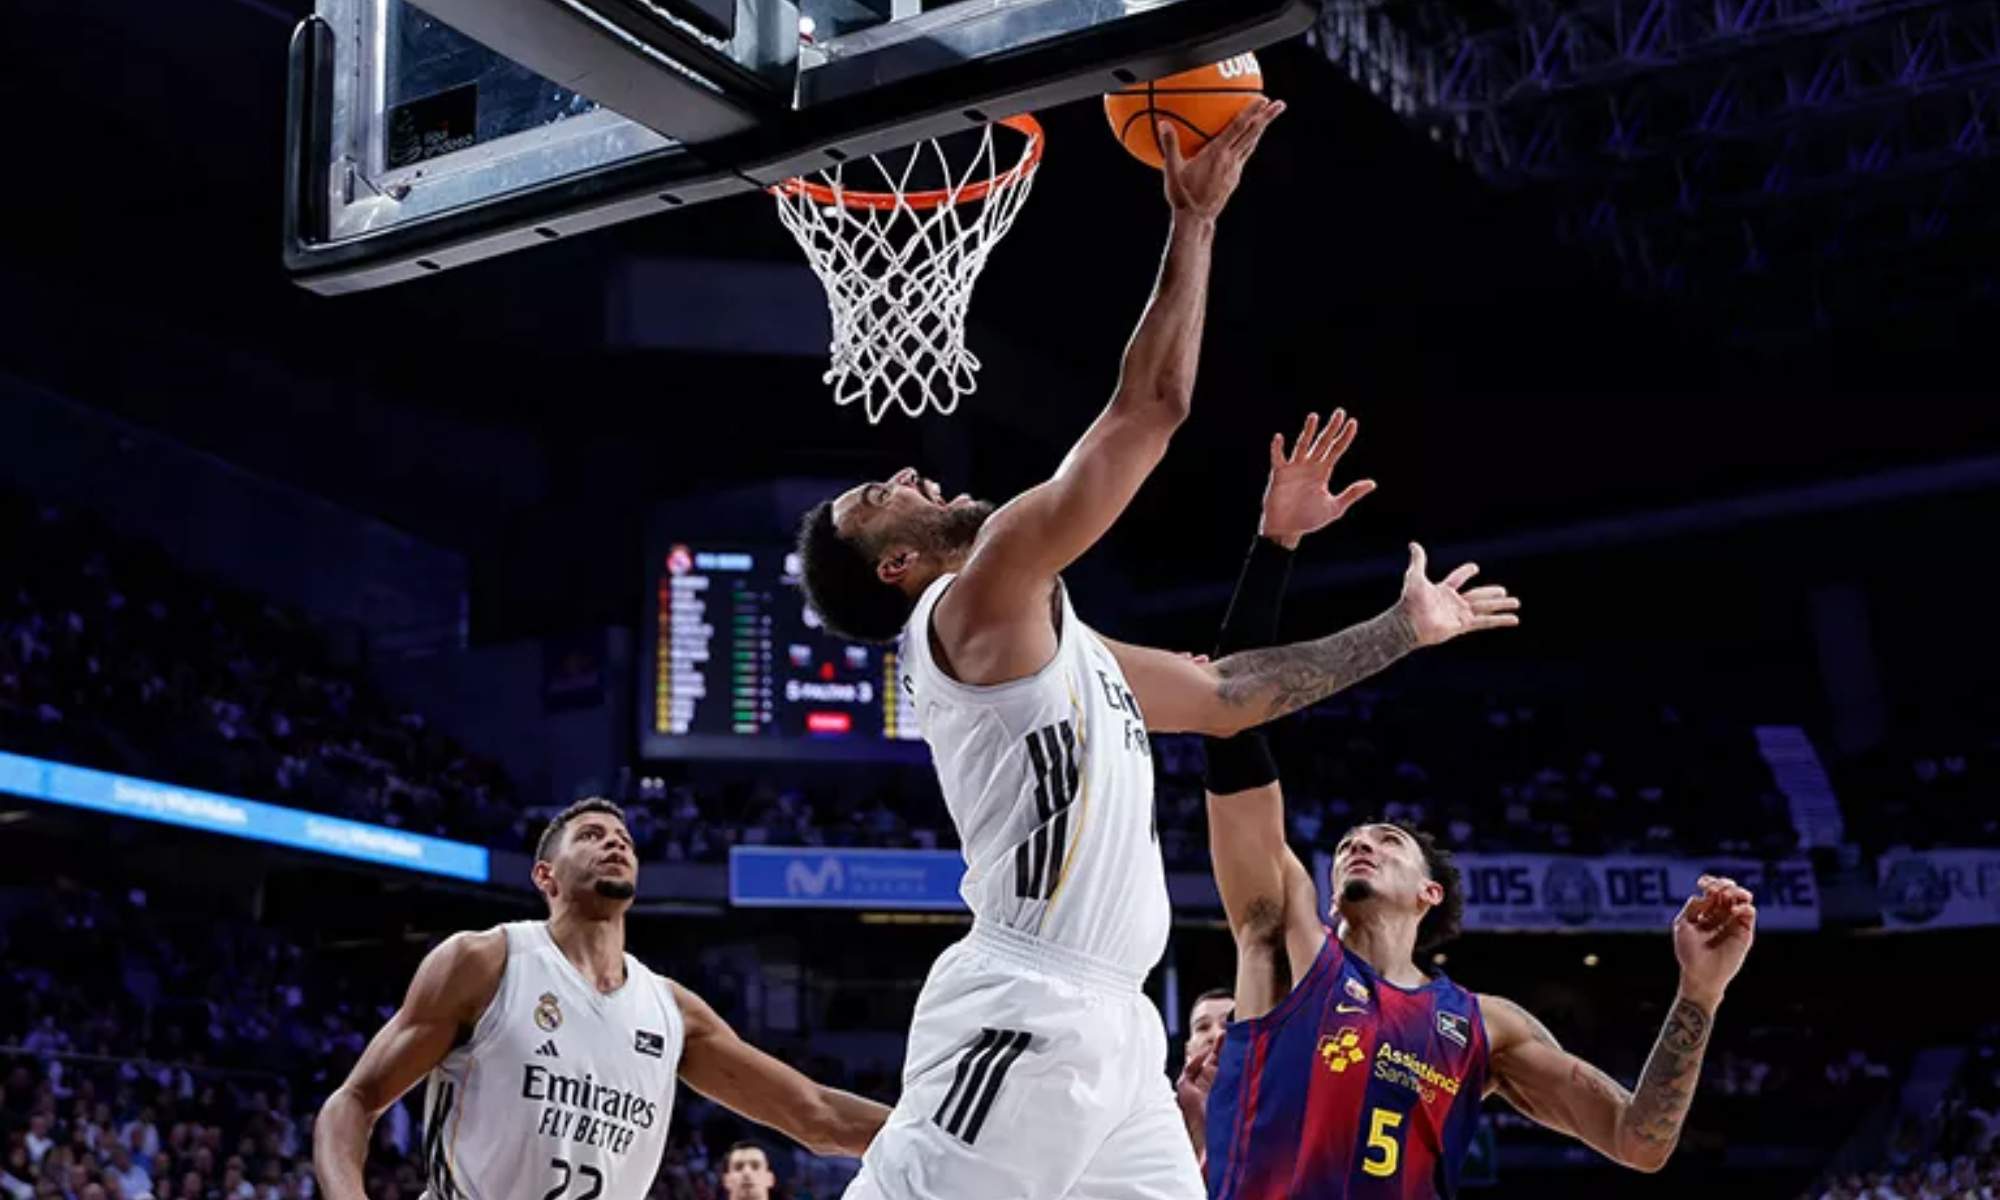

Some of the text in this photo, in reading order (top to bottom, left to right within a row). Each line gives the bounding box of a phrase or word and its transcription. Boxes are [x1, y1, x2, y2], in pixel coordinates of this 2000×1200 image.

[1605, 866, 1686, 907] DEL
[522, 1063, 656, 1129] Emirates
[538, 1107, 634, 1155] FLY BETTER
[1362, 1107, 1403, 1187] 5
